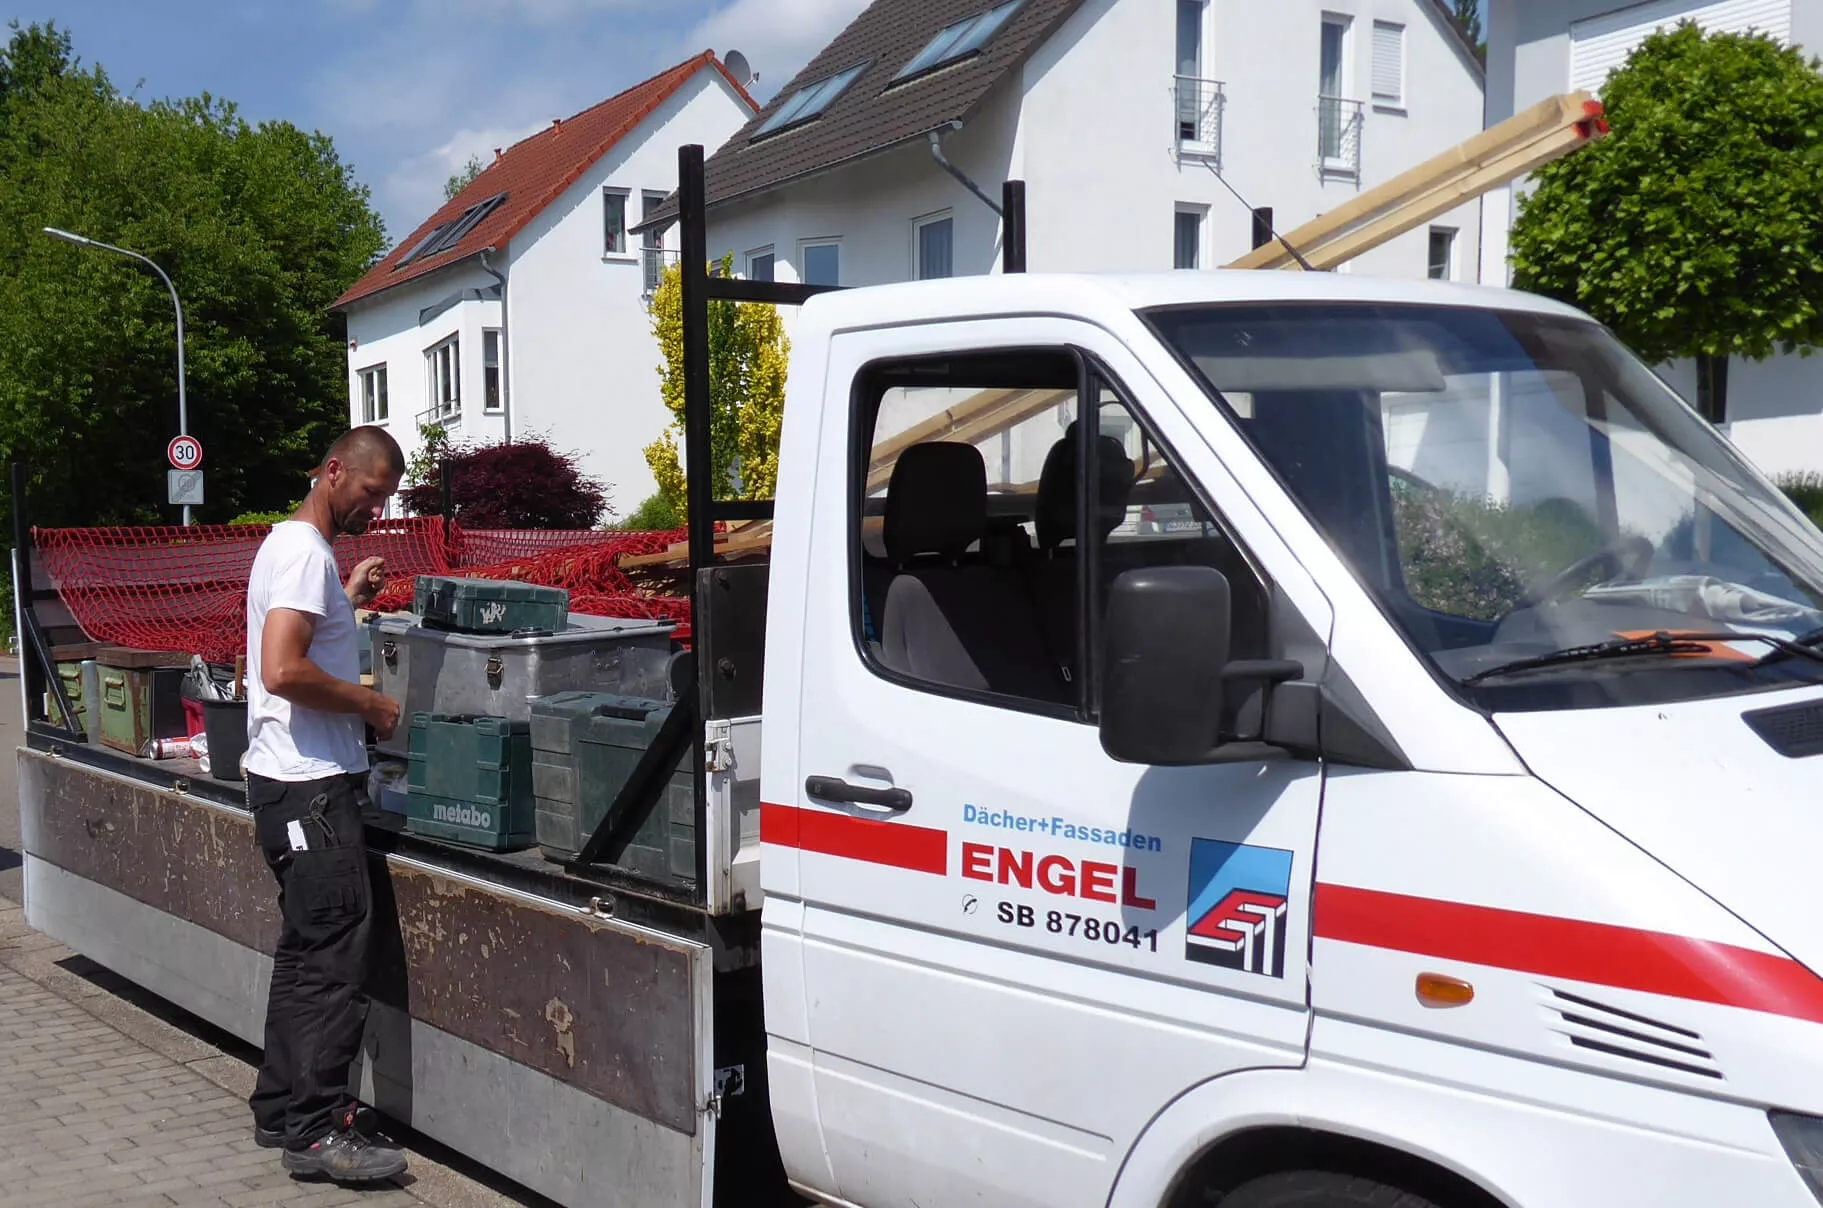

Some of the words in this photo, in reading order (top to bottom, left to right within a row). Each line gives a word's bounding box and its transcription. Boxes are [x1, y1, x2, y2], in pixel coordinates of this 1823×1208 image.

[175, 445, 195, 460] 30
[433, 803, 491, 828] metabo
[963, 803, 1162, 852] Dächer+Fassaden
[961, 841, 1156, 911] ENGEL
[997, 901, 1035, 928] SB
[1046, 911, 1157, 952] 878041
